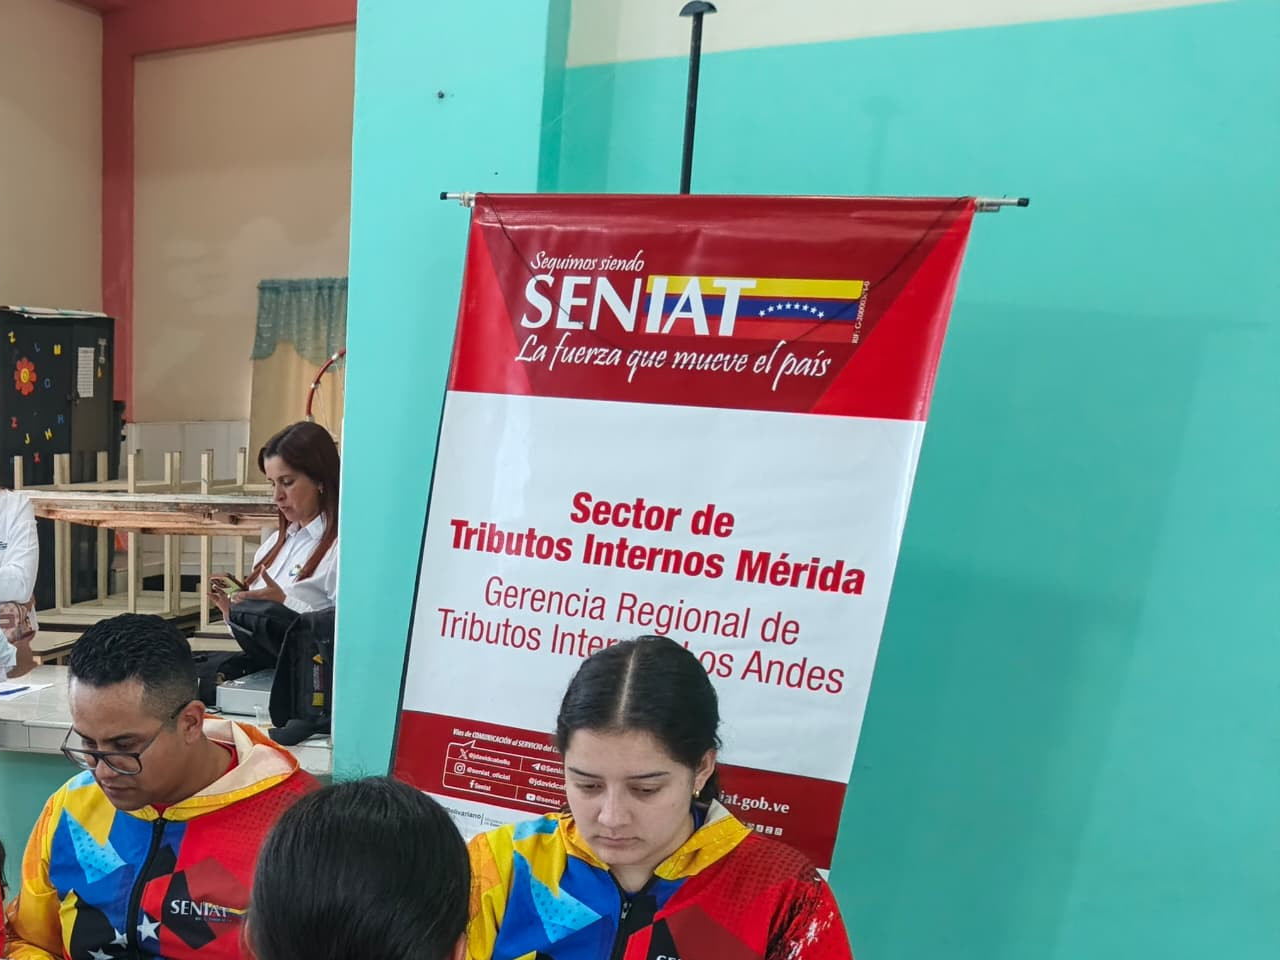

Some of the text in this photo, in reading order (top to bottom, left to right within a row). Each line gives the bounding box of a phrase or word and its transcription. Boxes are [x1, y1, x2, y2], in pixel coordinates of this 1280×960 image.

[530, 249, 644, 276] Seguimos siendo
[520, 274, 757, 337] SENIAT
[515, 331, 832, 392] La fuerza que mueve el país
[570, 491, 735, 538] Sector de
[450, 519, 866, 595] Tributos Internos Mérida
[484, 575, 801, 646] Gerencia Regional de
[437, 608, 542, 651] Tributos
[551, 624, 619, 658] Inter
[740, 650, 845, 694] Andes
[720, 790, 790, 814] iat.gob.ve
[170, 899, 227, 918] SENIAT
